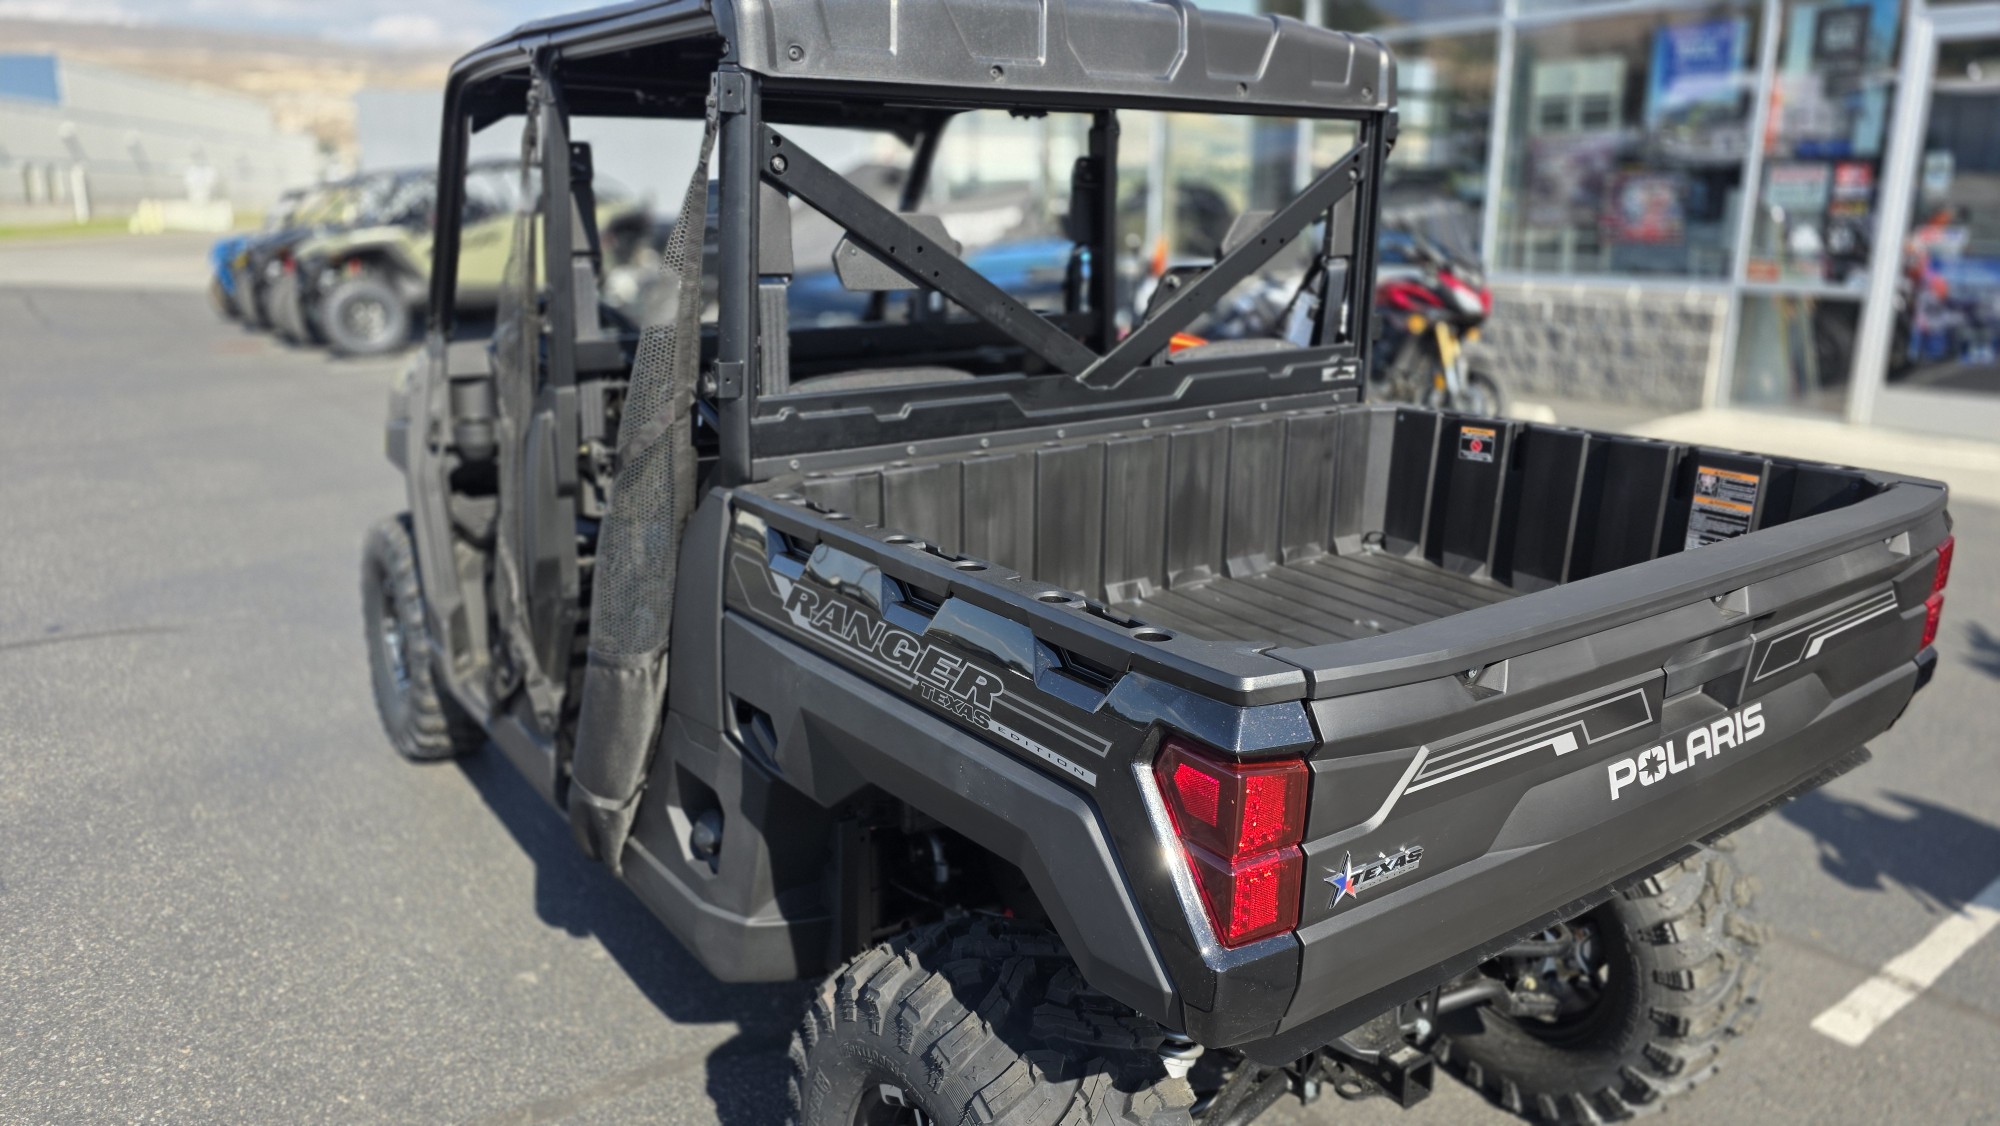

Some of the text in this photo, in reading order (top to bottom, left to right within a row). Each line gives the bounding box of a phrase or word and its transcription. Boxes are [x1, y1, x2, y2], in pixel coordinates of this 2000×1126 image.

[783, 583, 1004, 711] RANGER
[921, 682, 1085, 777] TEXAS EDITION
[1608, 702, 1766, 801] POLARIS
[1350, 846, 1424, 887] TEXAS
